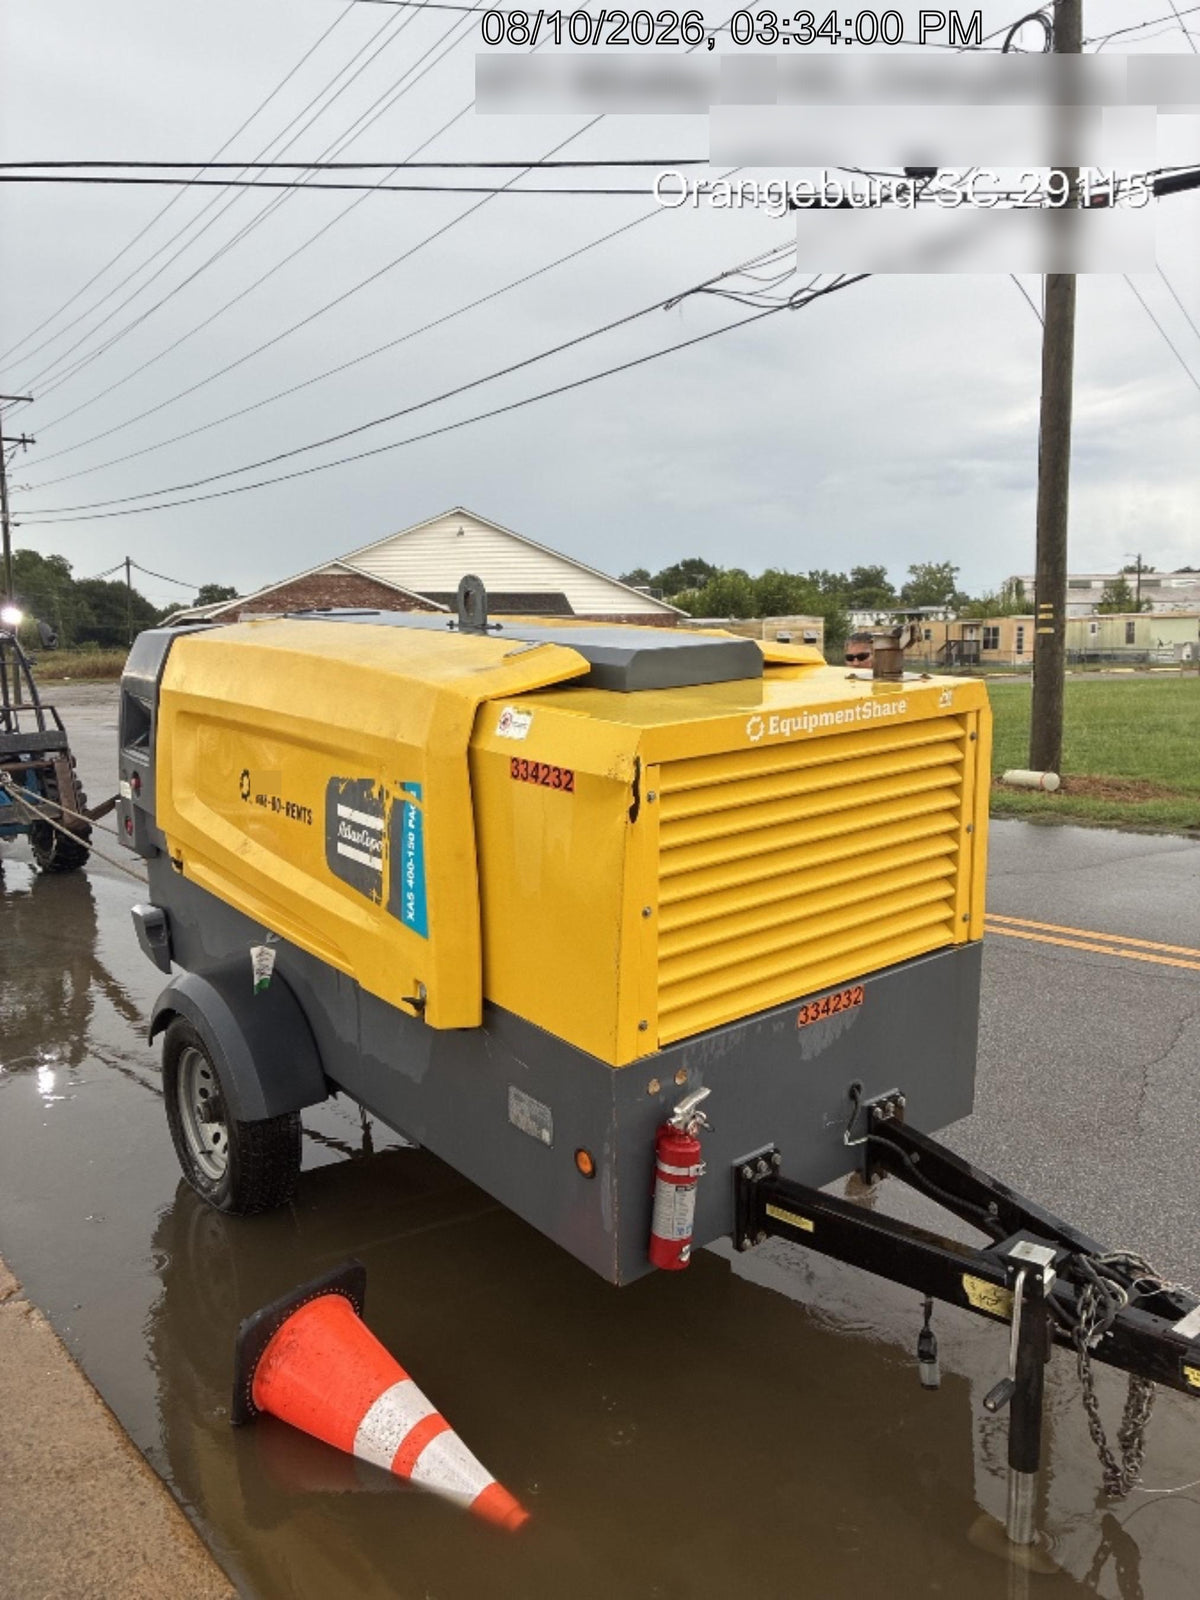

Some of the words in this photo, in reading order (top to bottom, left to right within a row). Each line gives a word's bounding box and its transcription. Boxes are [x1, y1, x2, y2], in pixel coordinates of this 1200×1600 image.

[767, 699, 907, 737] EquipmentShare
[511, 757, 574, 793] 334232
[406, 833, 416, 889] 400-150
[405, 893, 416, 922] XAS
[799, 985, 864, 1025] 334232
